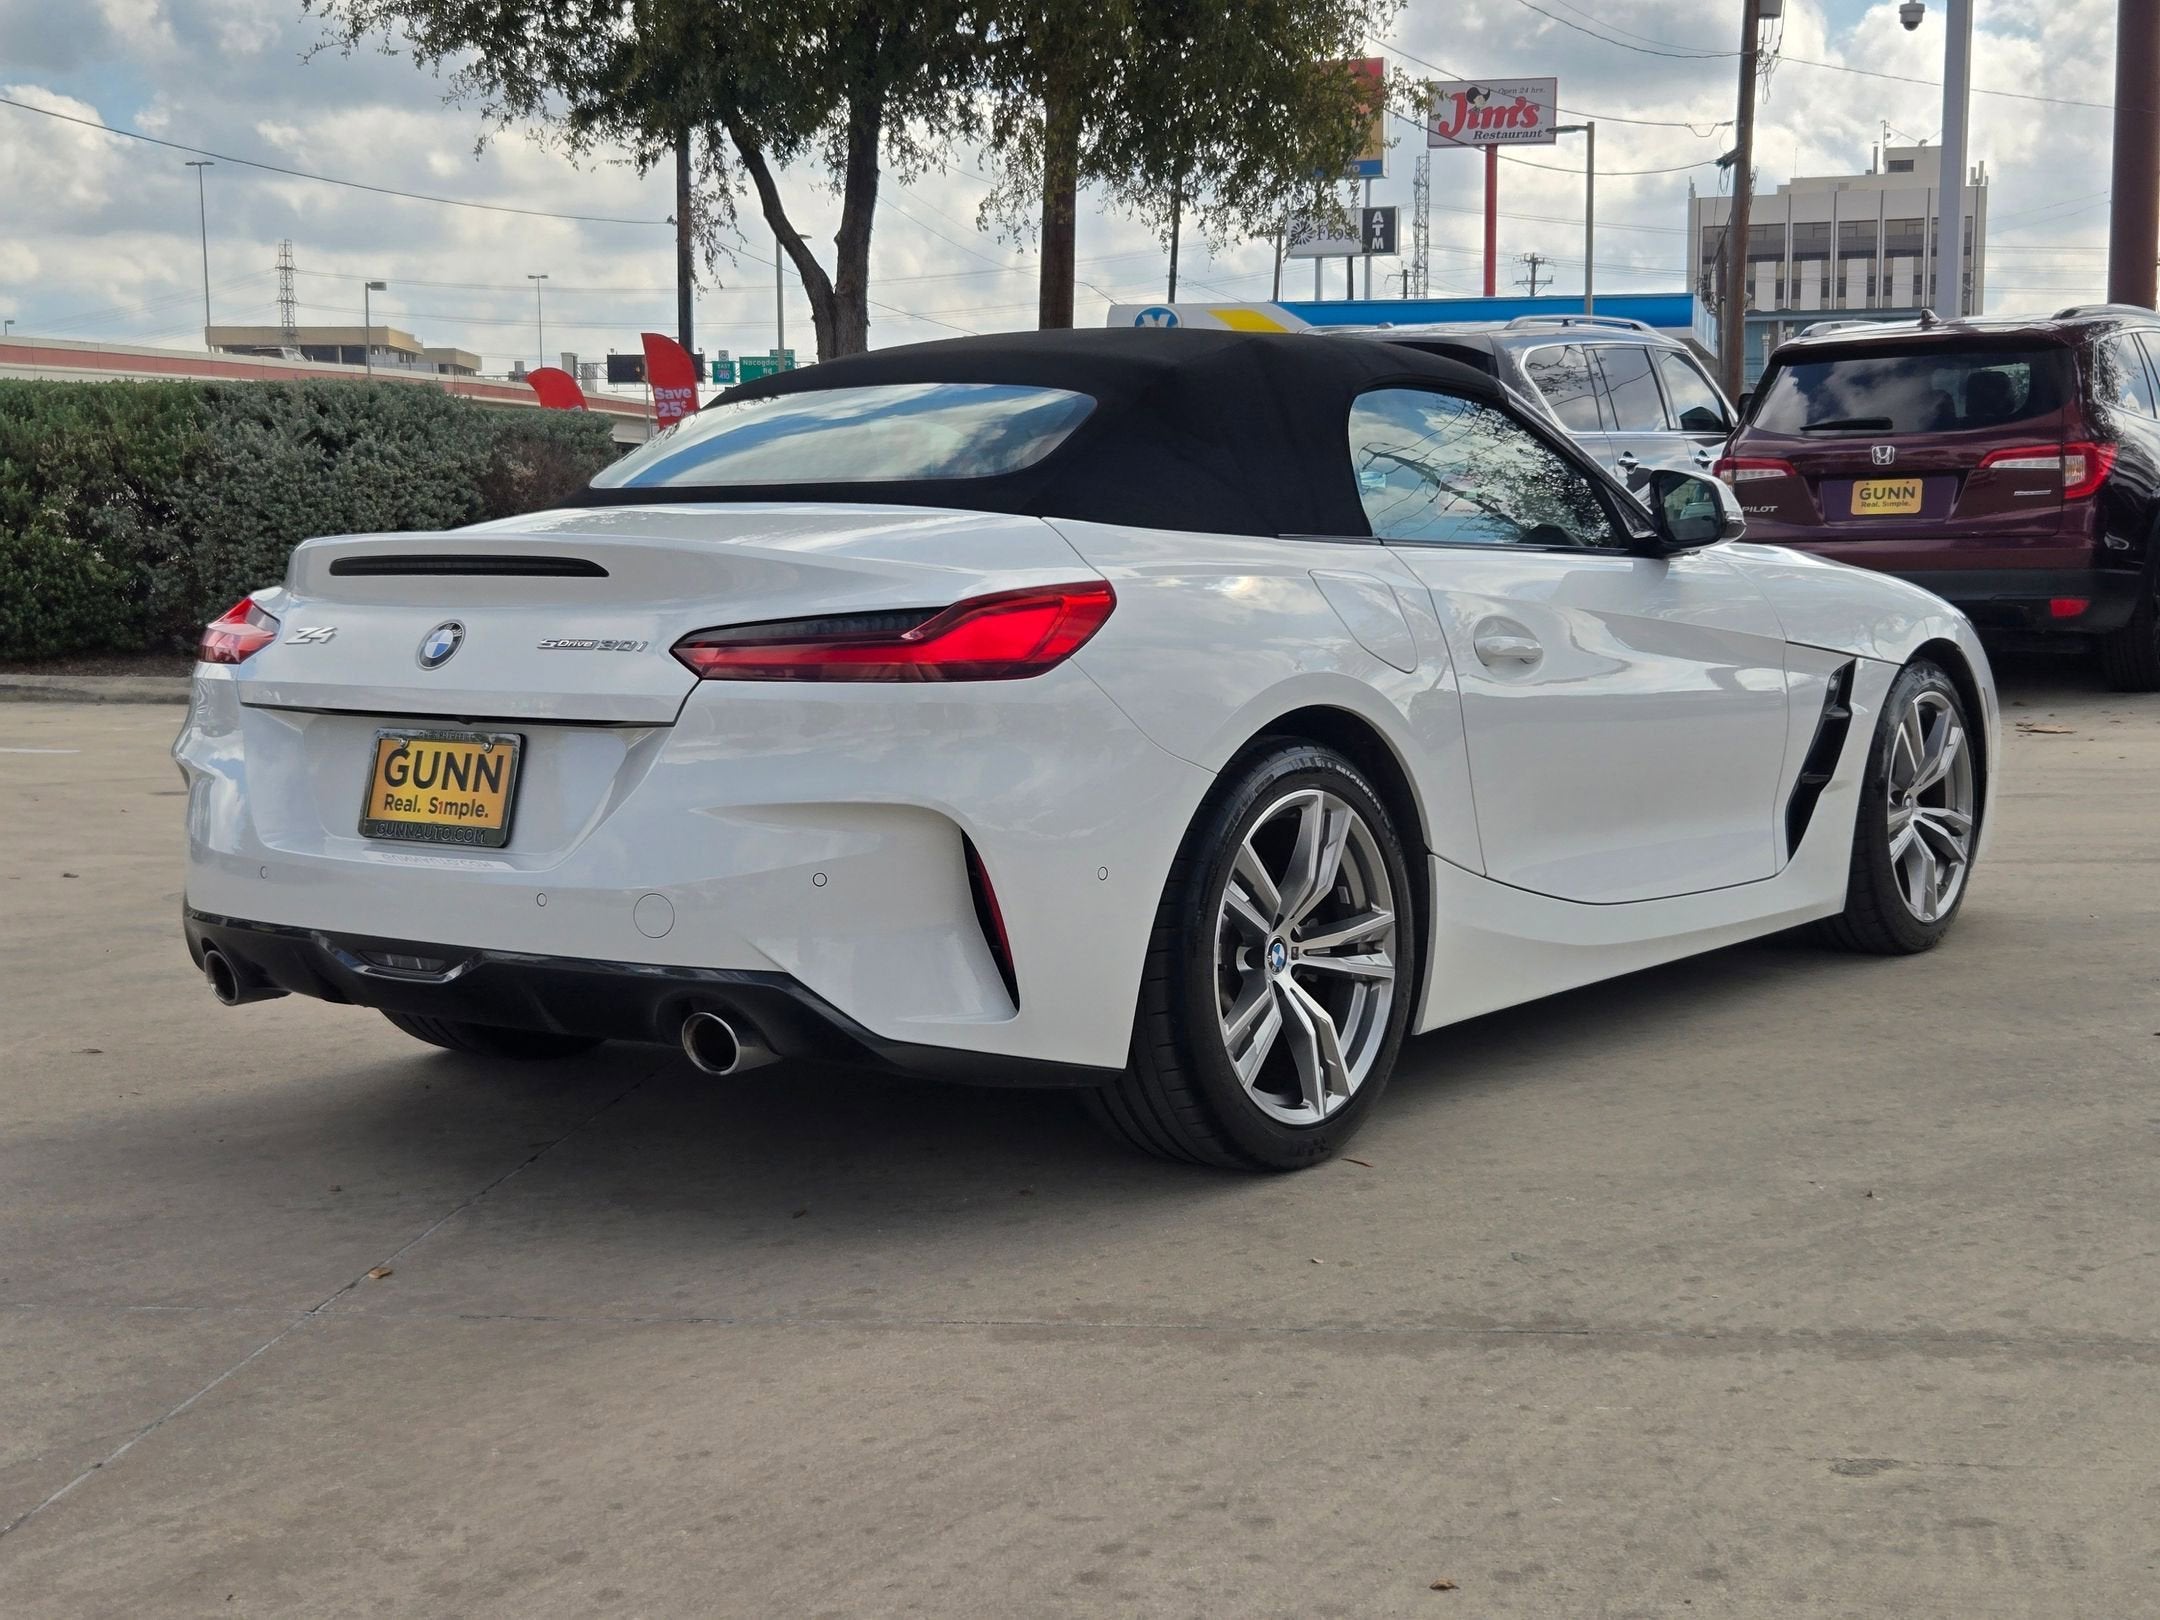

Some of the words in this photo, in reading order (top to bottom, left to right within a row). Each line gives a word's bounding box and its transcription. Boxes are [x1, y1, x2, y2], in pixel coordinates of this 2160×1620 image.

[1438, 94, 1540, 138] Jim's
[1473, 129, 1543, 140] Restaurant
[1371, 210, 1384, 250] ATM
[742, 359, 792, 367] Nacogdocs
[655, 387, 692, 400] Save
[1860, 486, 1916, 501] GUNN
[1742, 505, 1778, 513] PILOT
[285, 626, 338, 646] Z4
[384, 748, 504, 794] GUNN
[384, 793, 421, 813] Real.
